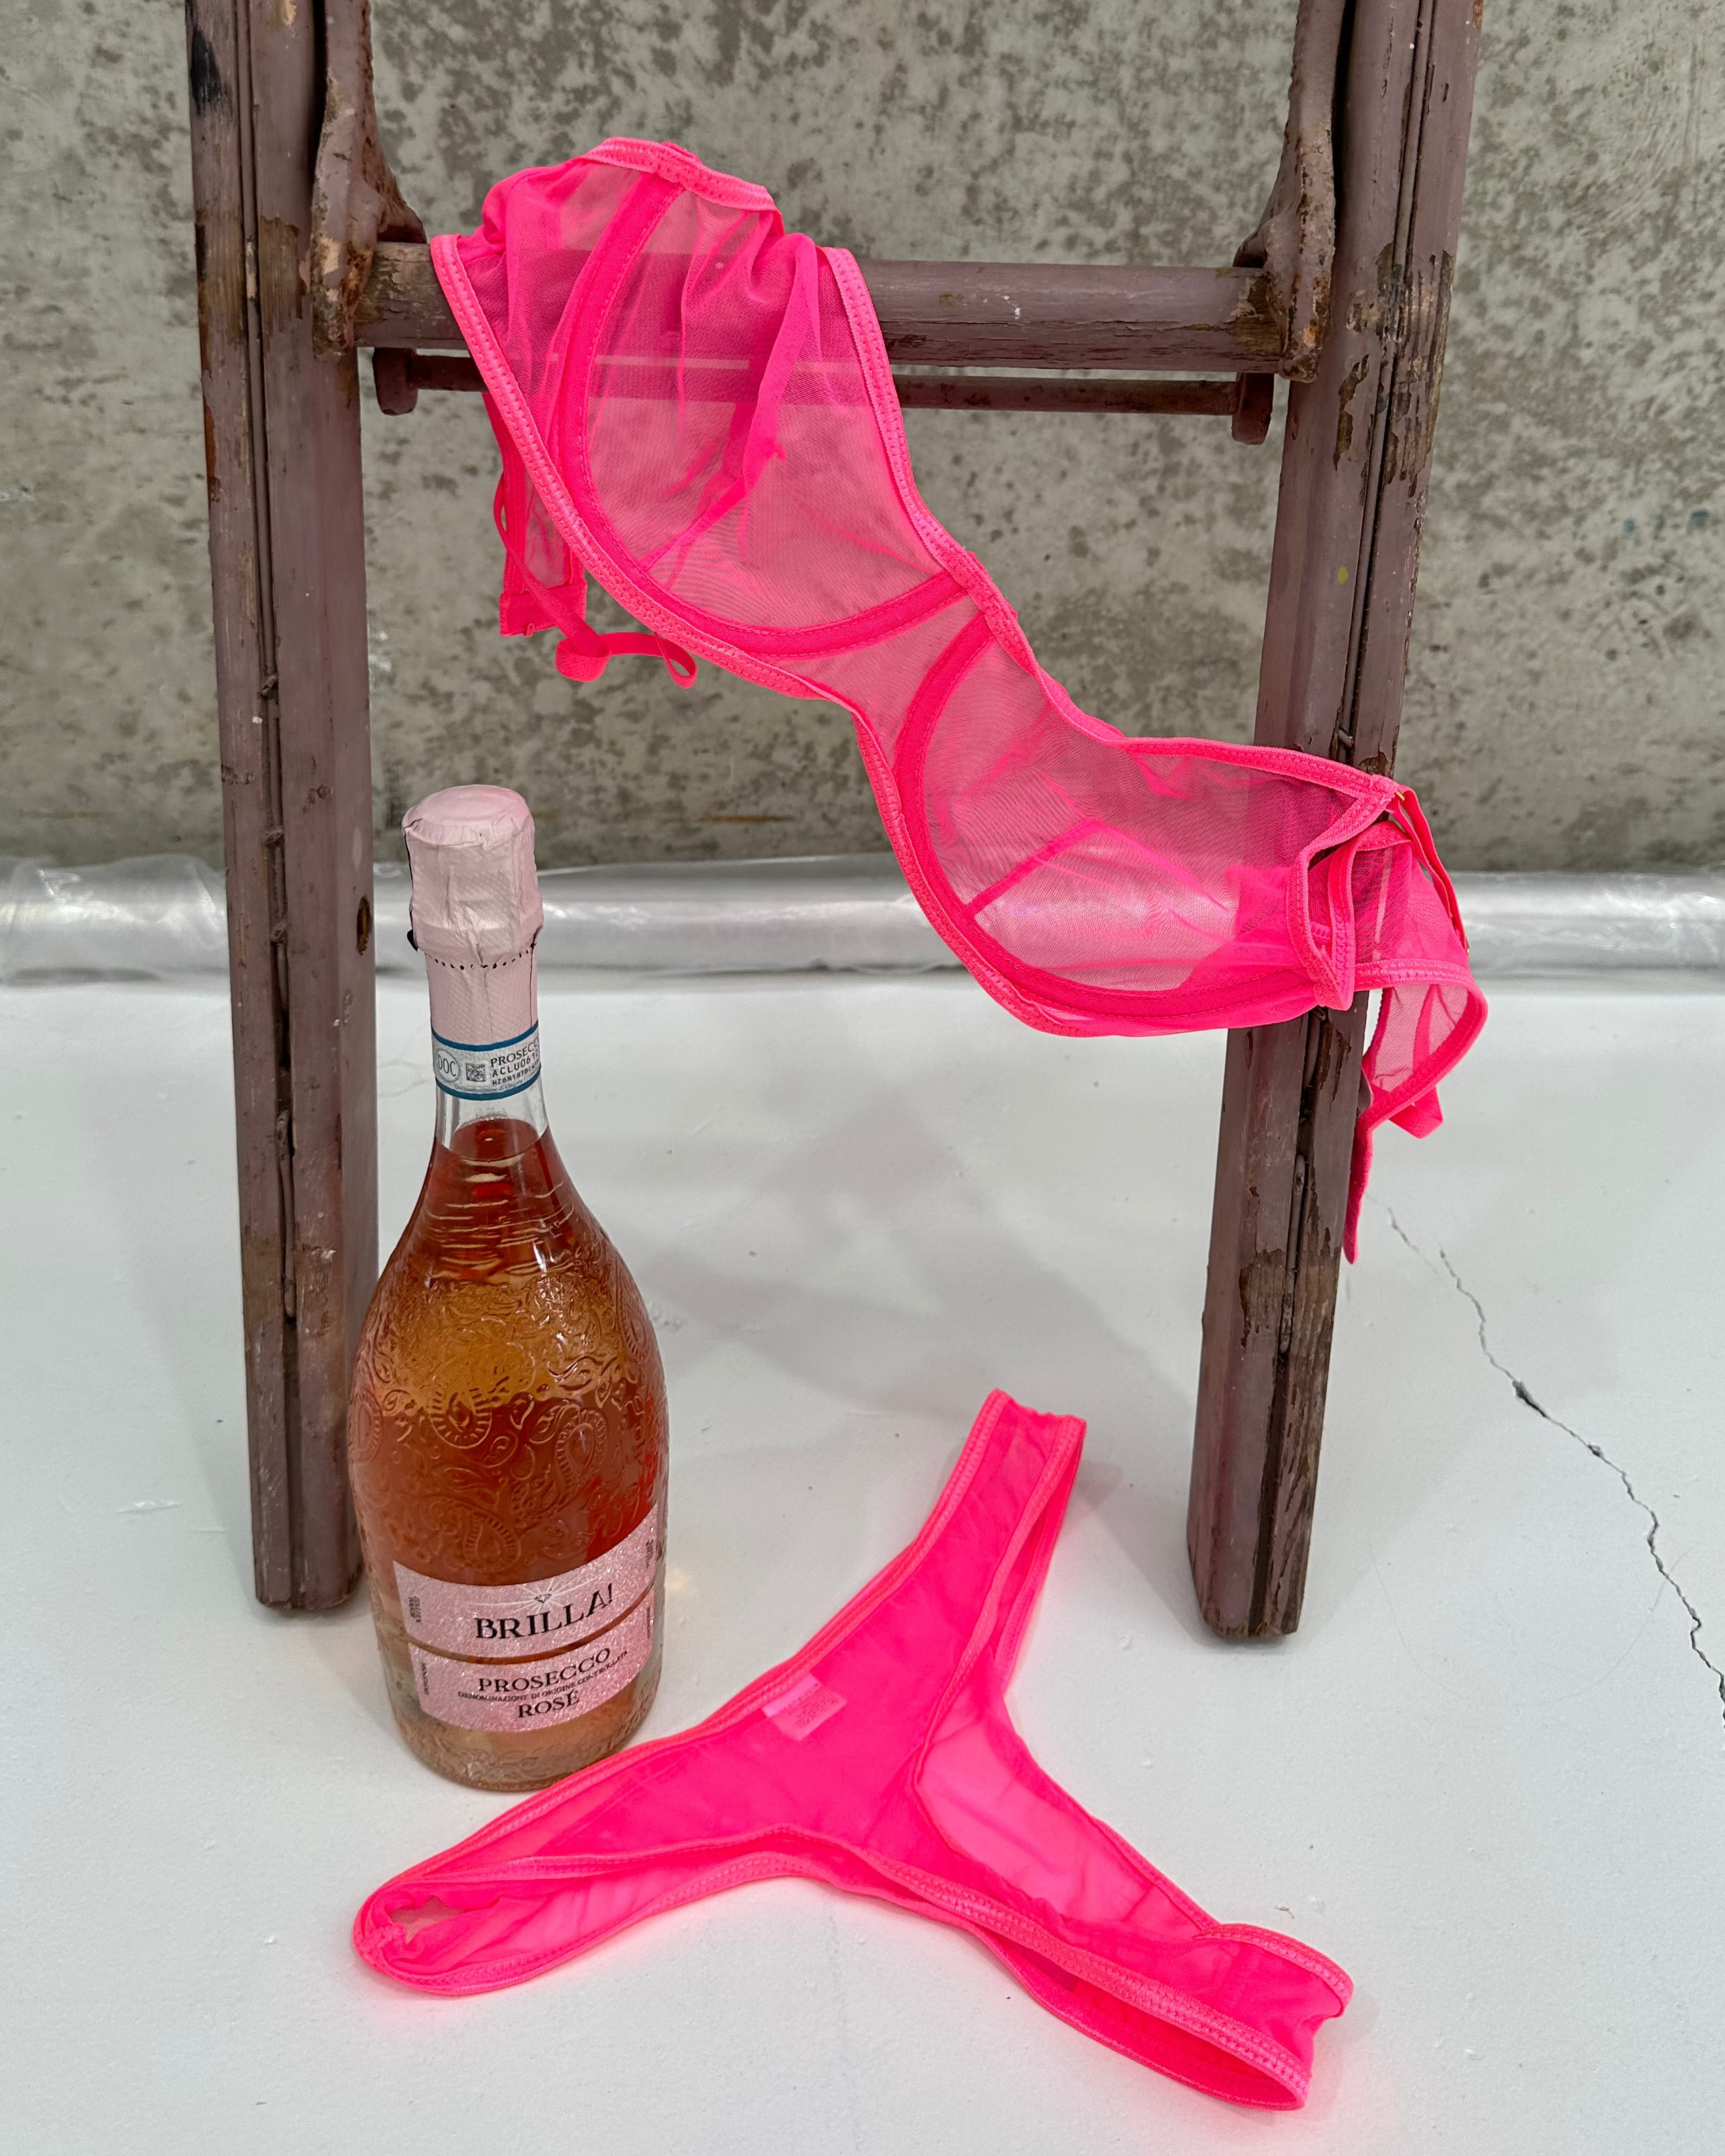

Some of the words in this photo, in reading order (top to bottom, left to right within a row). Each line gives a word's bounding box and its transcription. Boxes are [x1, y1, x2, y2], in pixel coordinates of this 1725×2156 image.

[438, 1054, 457, 1077] DOC
[475, 1583, 614, 1640] BRILLA!
[457, 1689, 527, 1702] DENOMINAZIONE
[531, 1691, 541, 1700] DI
[542, 1682, 578, 1697] ORIGINE
[577, 1650, 629, 1684] CONTROLLATA
[478, 1648, 610, 1693] PROSECCO
[517, 1689, 580, 1718] ROSÉ
